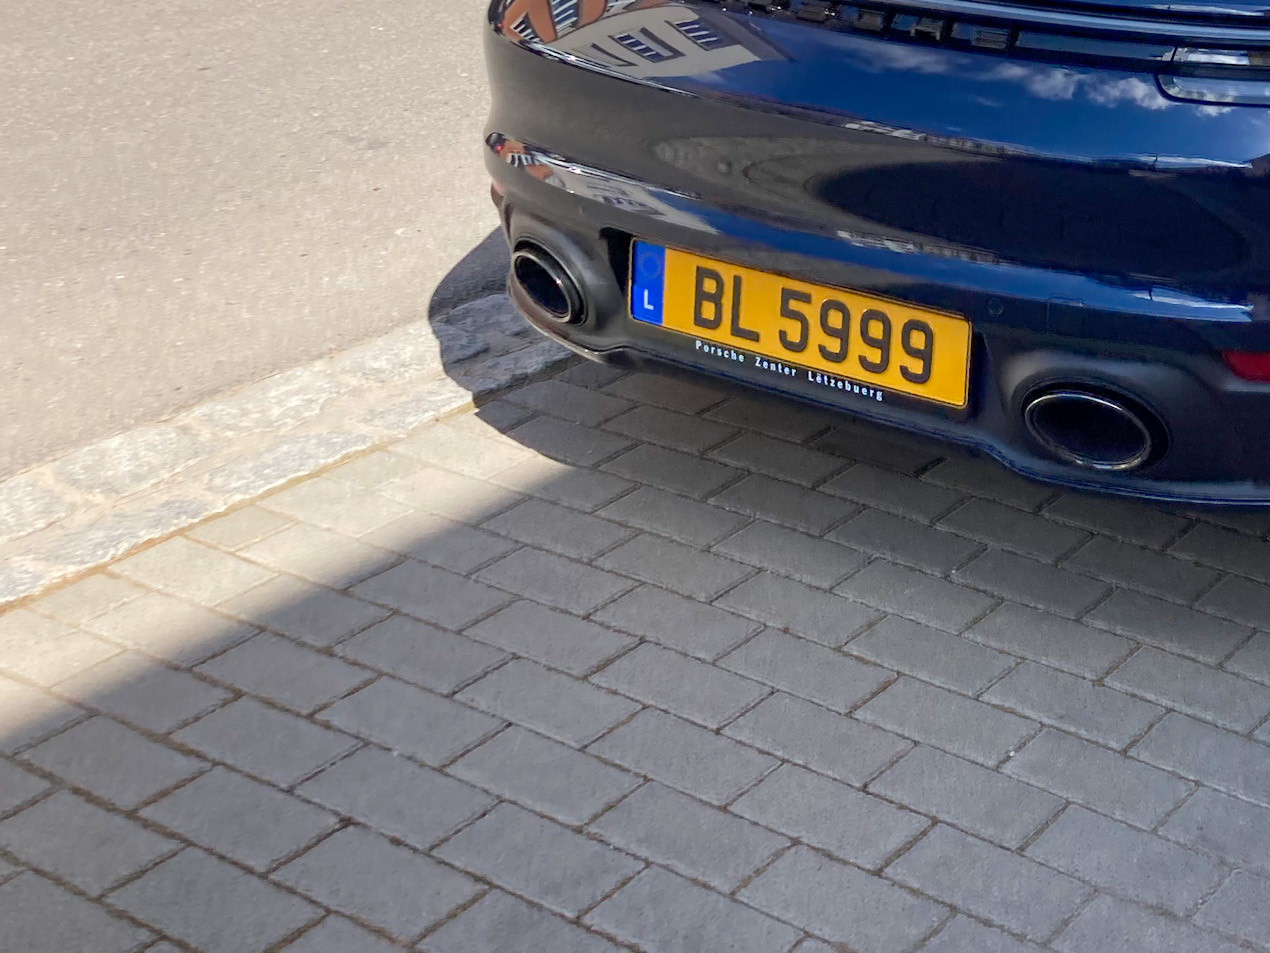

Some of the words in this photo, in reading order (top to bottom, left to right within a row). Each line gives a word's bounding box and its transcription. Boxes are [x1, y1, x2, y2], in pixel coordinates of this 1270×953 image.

[643, 289, 654, 310] L
[693, 265, 760, 342] BL
[778, 287, 934, 385] 5999
[695, 340, 745, 363] Porsche
[755, 356, 797, 377] Zenter
[807, 370, 884, 401] Lëtzebuerg
